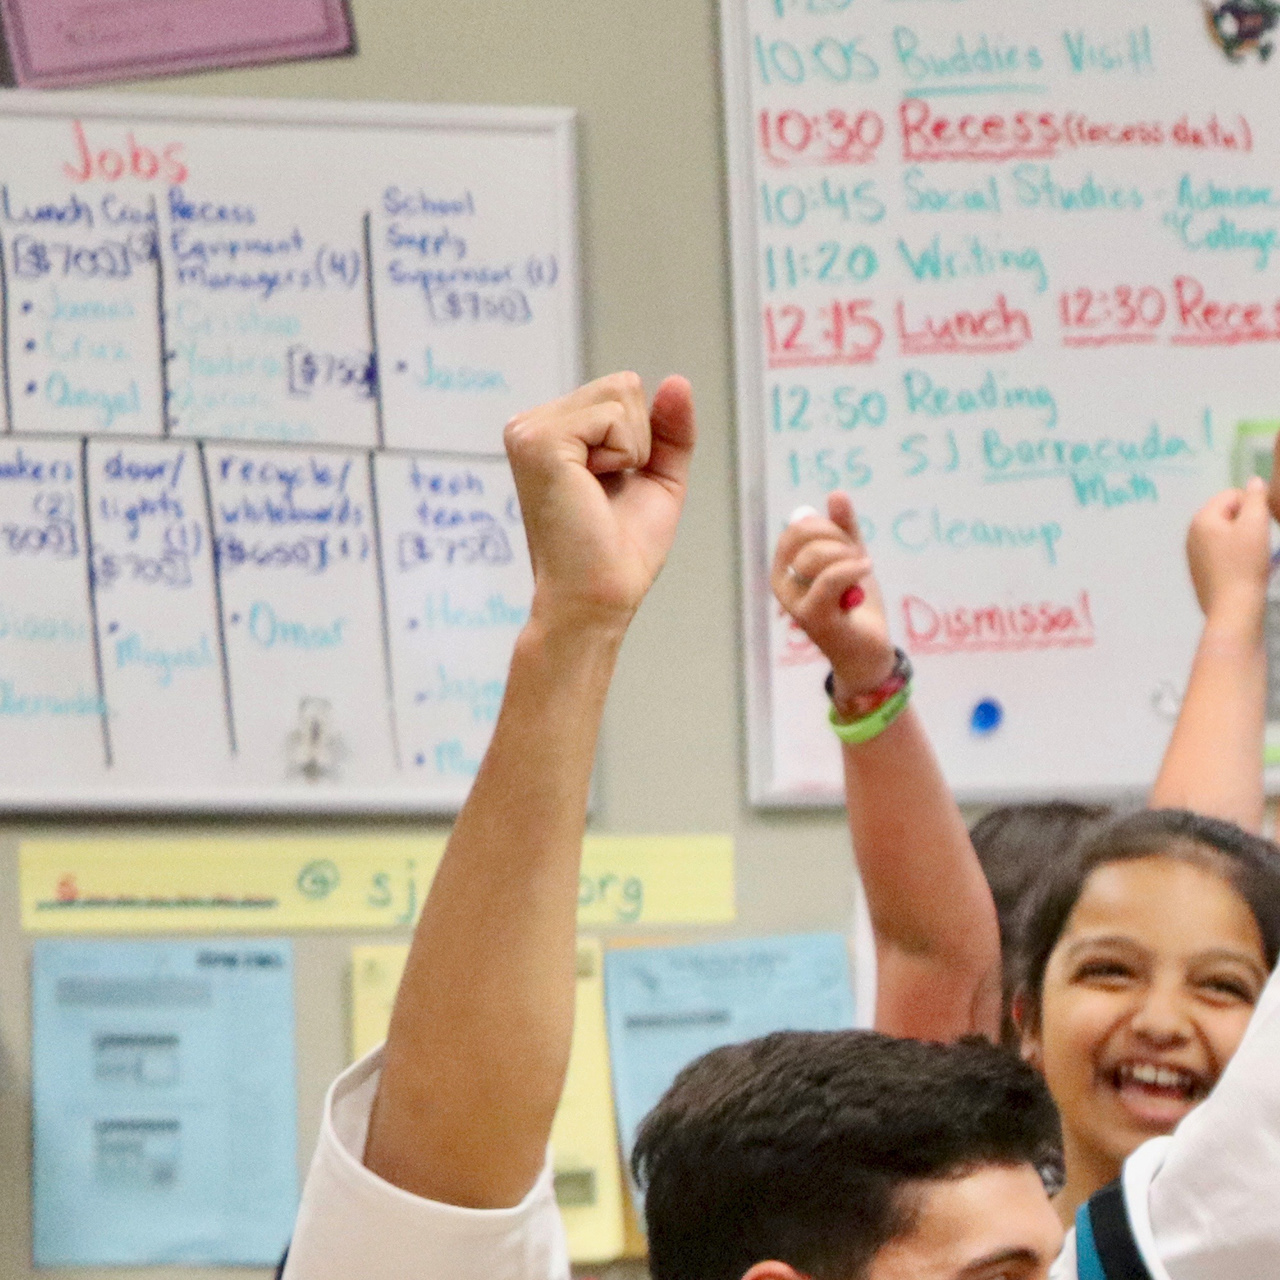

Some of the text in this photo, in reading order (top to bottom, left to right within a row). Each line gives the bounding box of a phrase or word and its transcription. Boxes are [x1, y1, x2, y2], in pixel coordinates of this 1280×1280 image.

[893, 25, 1046, 82] Buddies
[62, 119, 189, 185] Jobs
[758, 106, 886, 154] 10:30
[900, 98, 1058, 149] Recess
[382, 186, 475, 216] School
[761, 180, 886, 226] 10:45
[902, 167, 1003, 213] Social
[1012, 163, 1144, 212] Studies
[766, 233, 1049, 293] 11:20 Writing
[764, 299, 884, 356] 12:15
[896, 295, 1033, 345] Lunch
[1058, 285, 1167, 329] 12:30
[772, 371, 1059, 432] 12:50 Reading
[892, 508, 1065, 566] Cleanup
[297, 858, 341, 899] @
